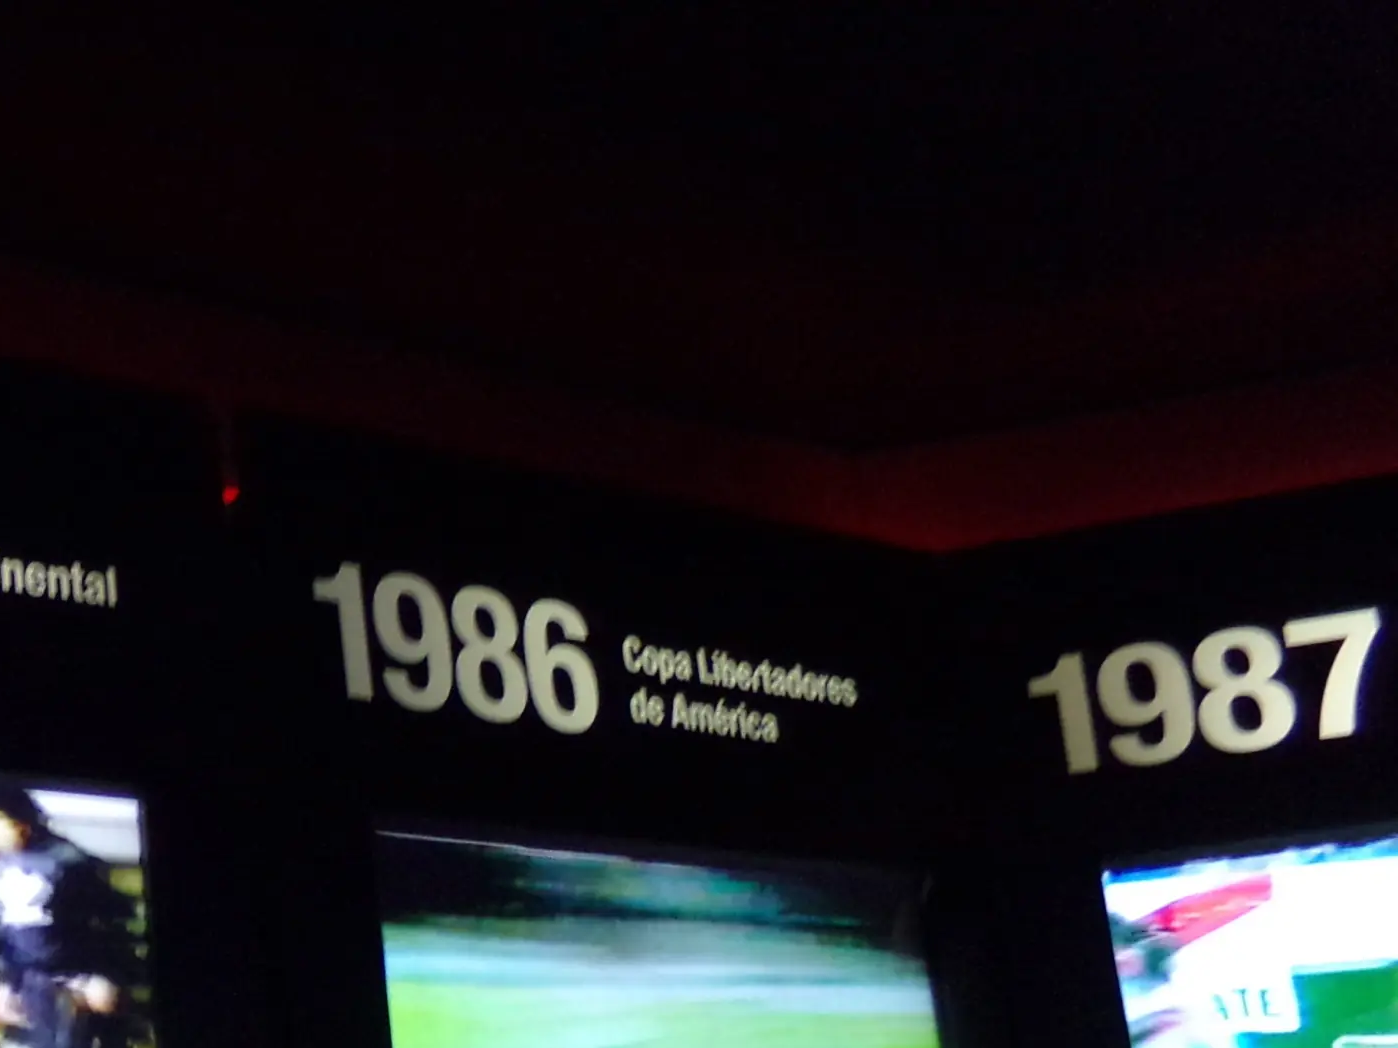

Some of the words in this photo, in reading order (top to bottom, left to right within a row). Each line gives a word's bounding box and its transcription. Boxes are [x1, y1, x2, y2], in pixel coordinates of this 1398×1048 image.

[312, 561, 601, 735] 1986
[622, 634, 693, 684] Copa
[696, 647, 858, 707] Libertadores
[1027, 605, 1383, 775] 1987
[630, 687, 665, 727] de
[671, 692, 780, 743] América
